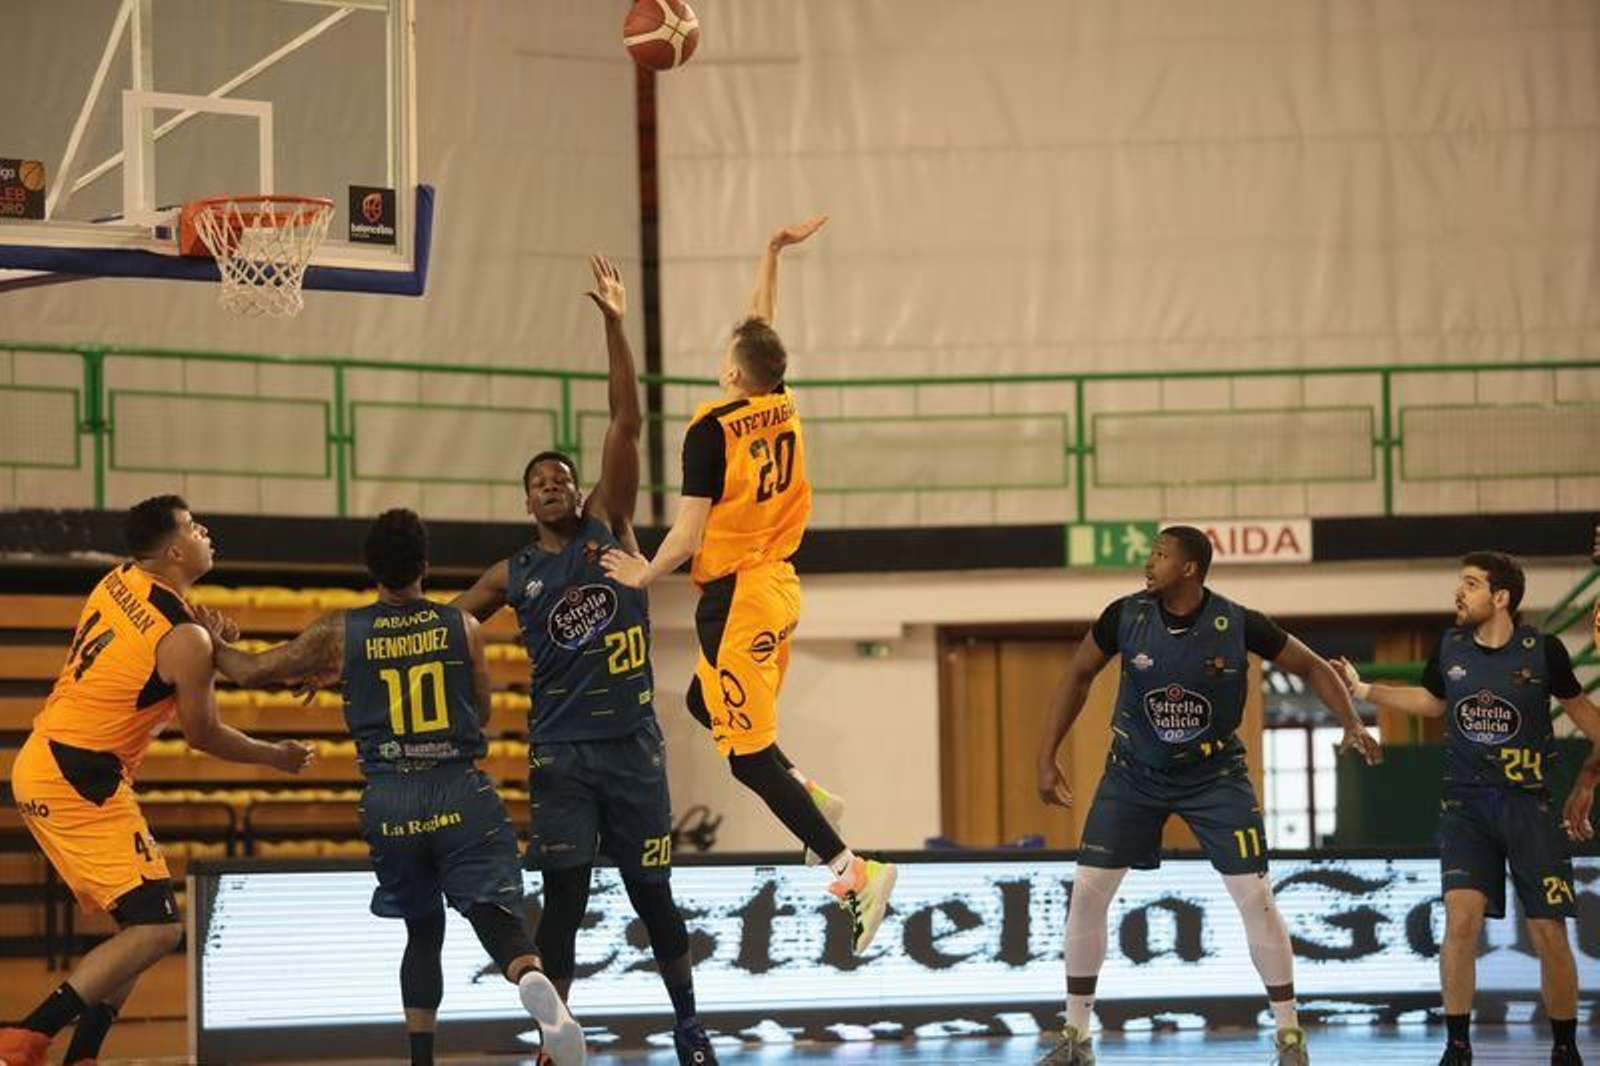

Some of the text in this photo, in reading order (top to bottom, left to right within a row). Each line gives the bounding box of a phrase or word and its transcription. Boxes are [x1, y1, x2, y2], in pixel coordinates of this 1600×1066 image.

[750, 430, 796, 503] 20
[1206, 526, 1302, 555] AIDA
[366, 627, 448, 660] HENRIQUEZ
[605, 625, 646, 674] 20
[380, 661, 449, 736] 10
[1461, 703, 1511, 720] Estrella
[1463, 716, 1509, 732] Galicia
[1501, 748, 1543, 781] 24
[382, 821, 404, 837] La
[1234, 827, 1261, 859] 11
[640, 832, 672, 867] 20
[1542, 877, 1575, 905] 24
